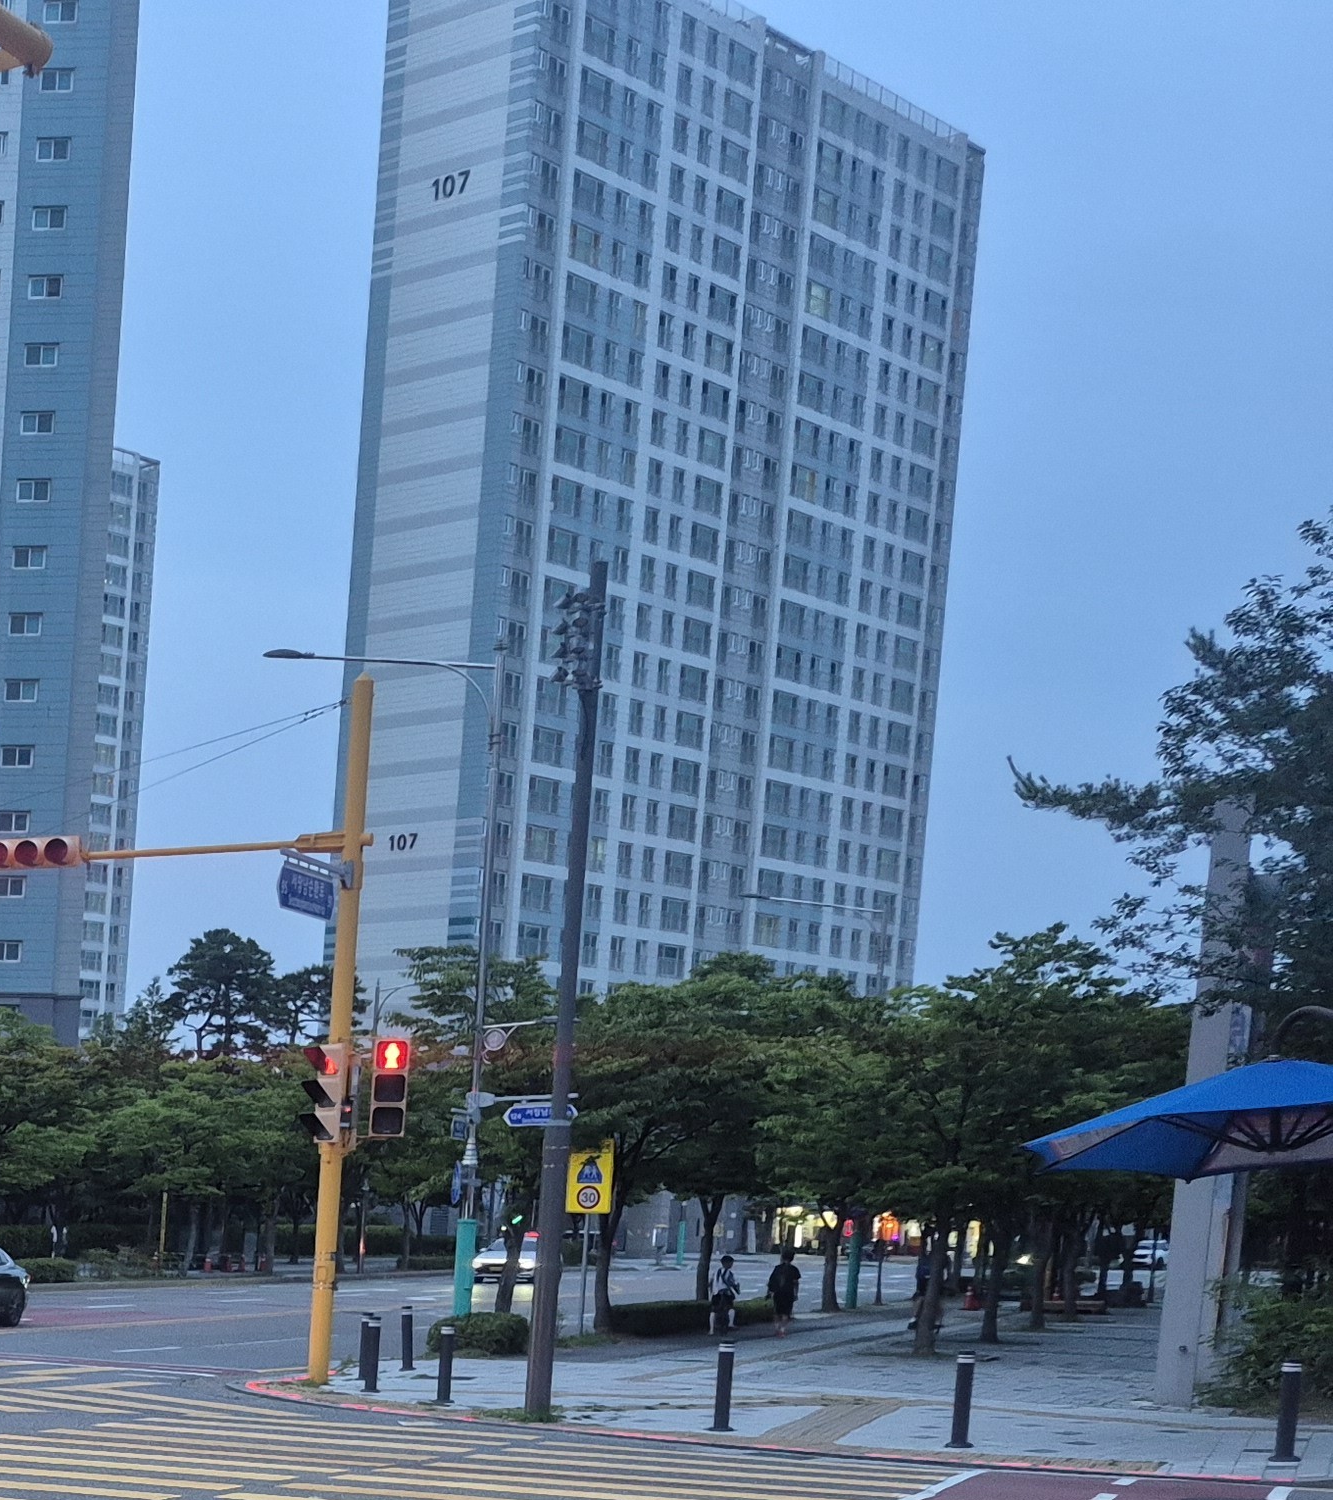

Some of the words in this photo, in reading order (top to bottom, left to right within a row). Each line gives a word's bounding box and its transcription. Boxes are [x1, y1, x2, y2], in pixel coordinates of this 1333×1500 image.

[432, 169, 471, 201] 107
[389, 832, 418, 851] 107
[581, 1192, 596, 1203] 30
